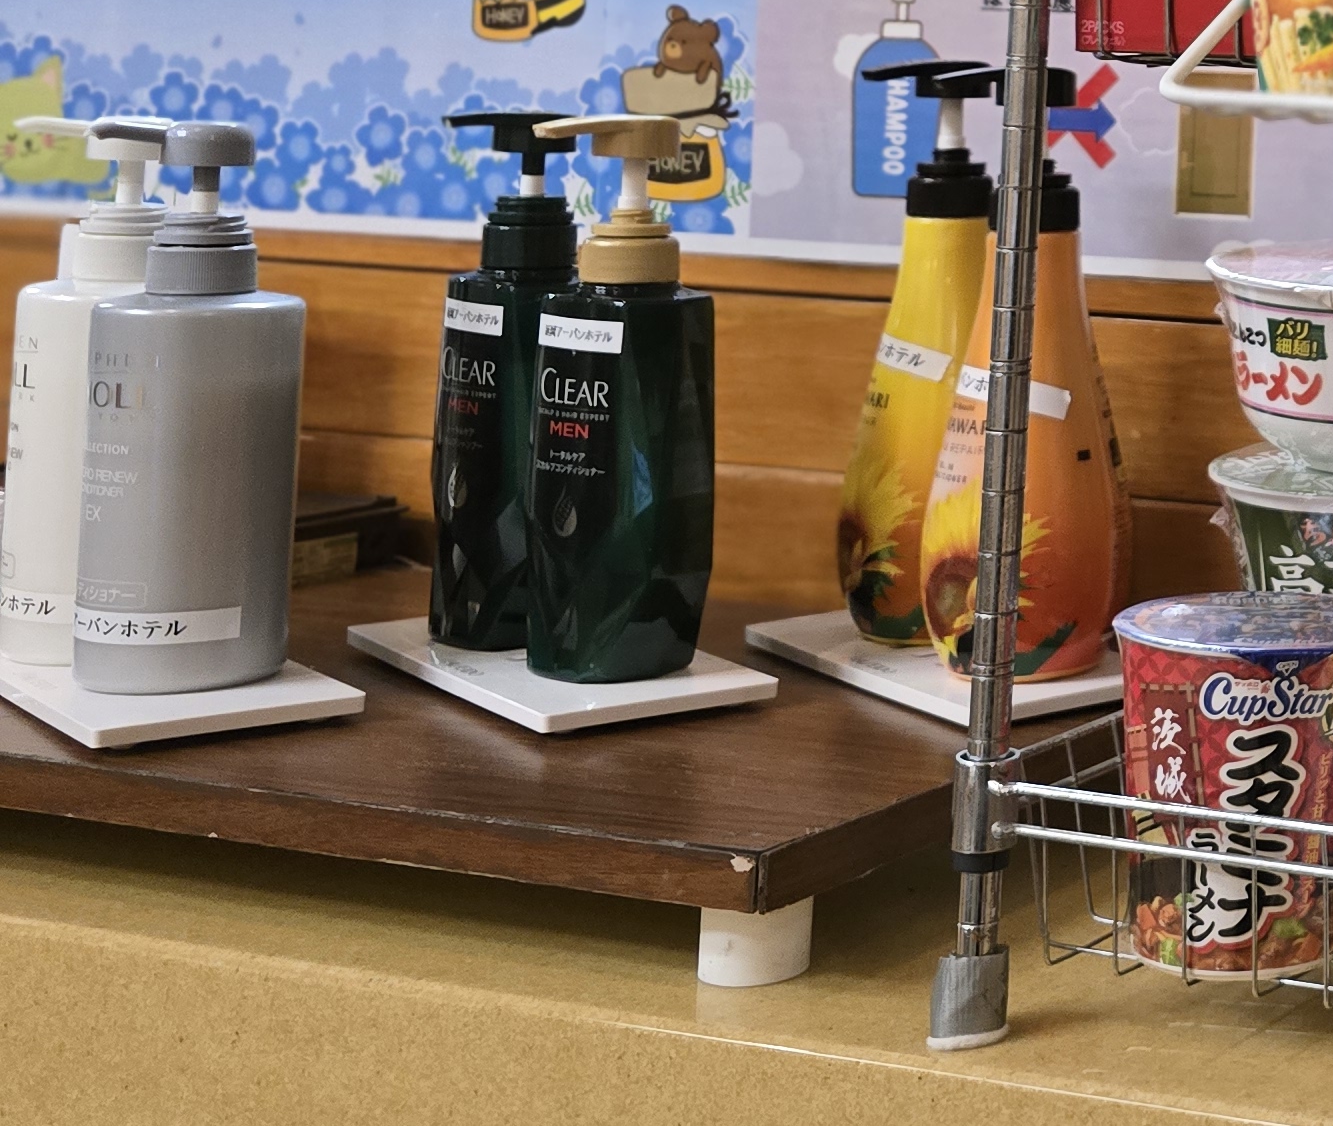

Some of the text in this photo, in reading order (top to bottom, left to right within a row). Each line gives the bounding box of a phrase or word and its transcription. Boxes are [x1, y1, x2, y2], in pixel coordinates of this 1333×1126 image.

[485, 3, 525, 28] HONEY
[1275, 320, 1311, 341] バリ
[1275, 337, 1319, 358] 細麺!
[441, 345, 497, 388] CLEAR
[1235, 350, 1323, 406] ラーメン
[539, 366, 611, 409] CLEAR
[447, 398, 480, 416] MEN
[549, 420, 591, 441] MEN
[1149, 707, 1192, 804] 茨城
